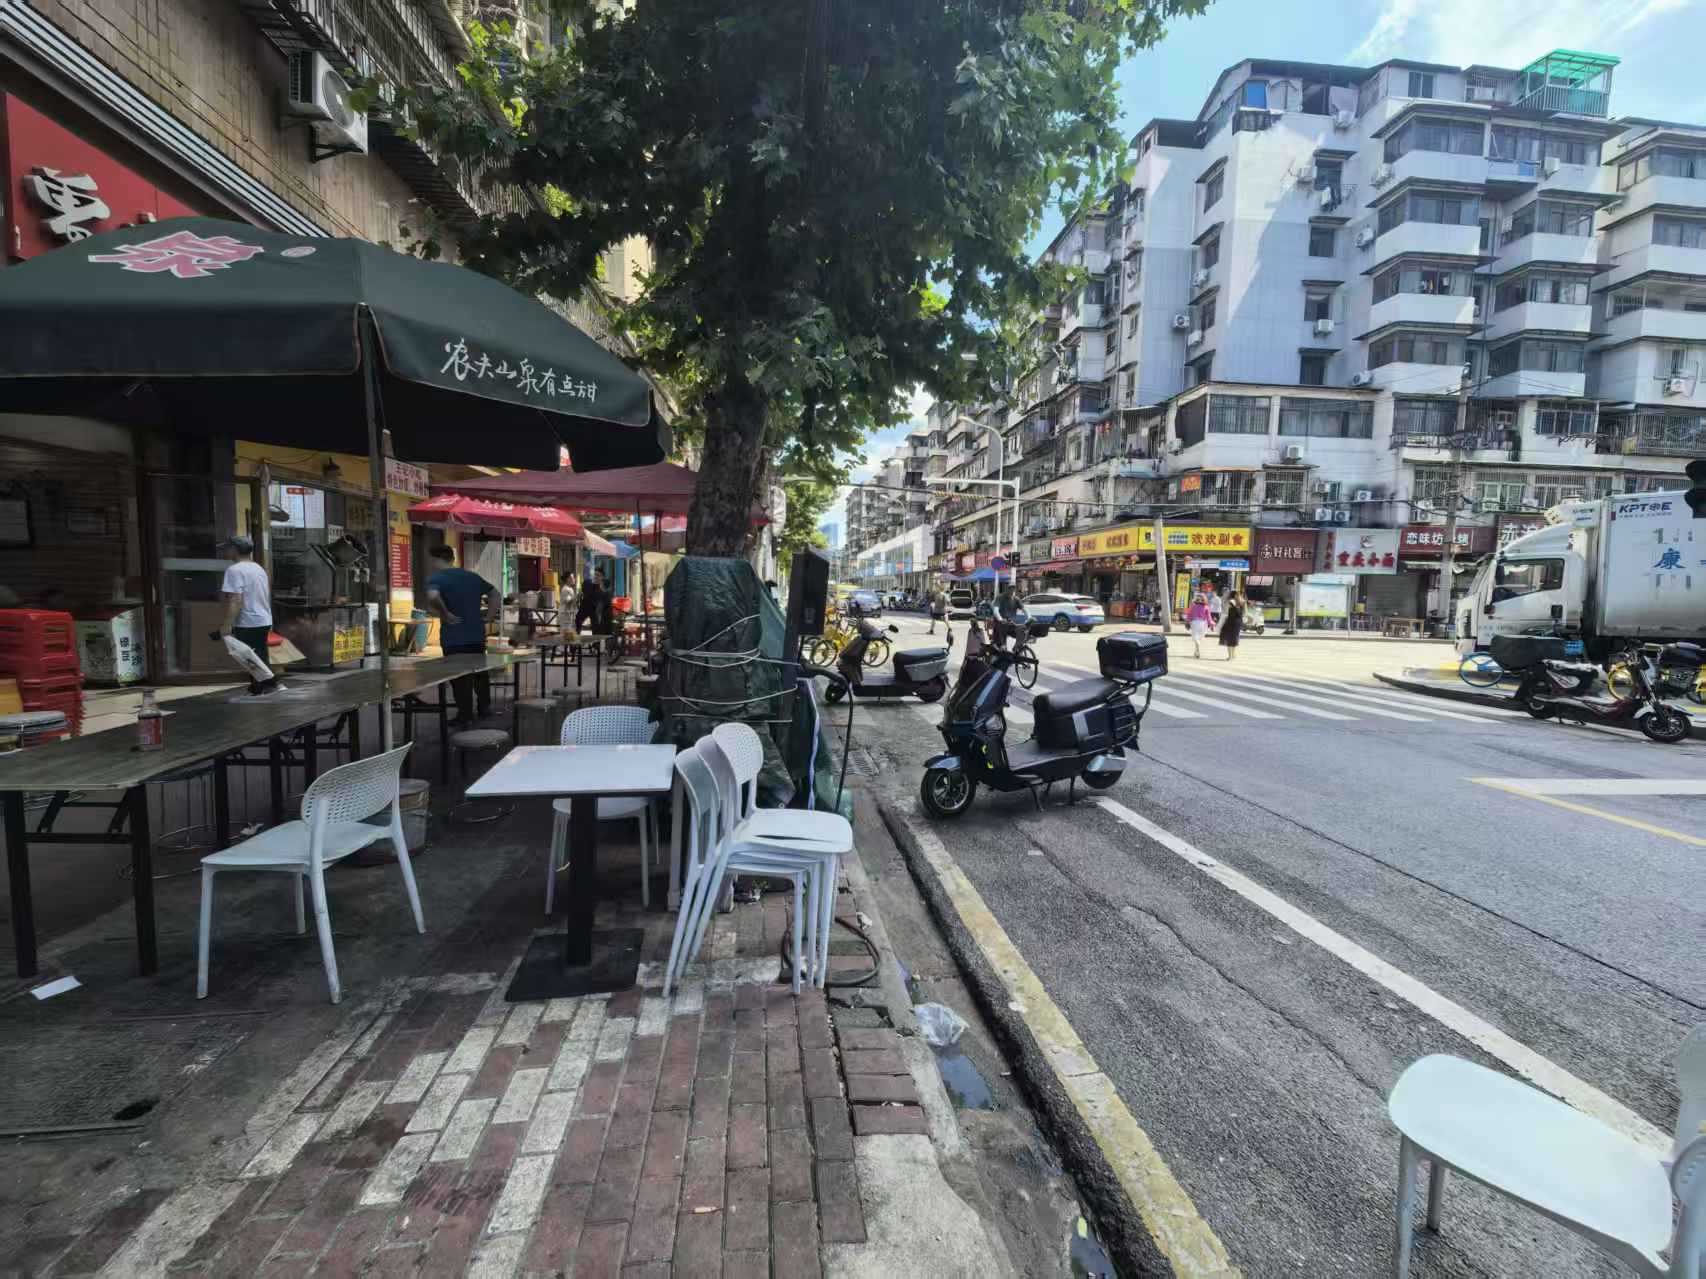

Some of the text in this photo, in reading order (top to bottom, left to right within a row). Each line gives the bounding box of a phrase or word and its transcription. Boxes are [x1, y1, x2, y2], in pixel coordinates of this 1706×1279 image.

[440, 336, 598, 403] 农夫山泉有点甜
[1191, 532, 1243, 546] 欢欢副食
[1337, 550, 1395, 568] 重庆小面
[1653, 547, 1687, 570] 康
